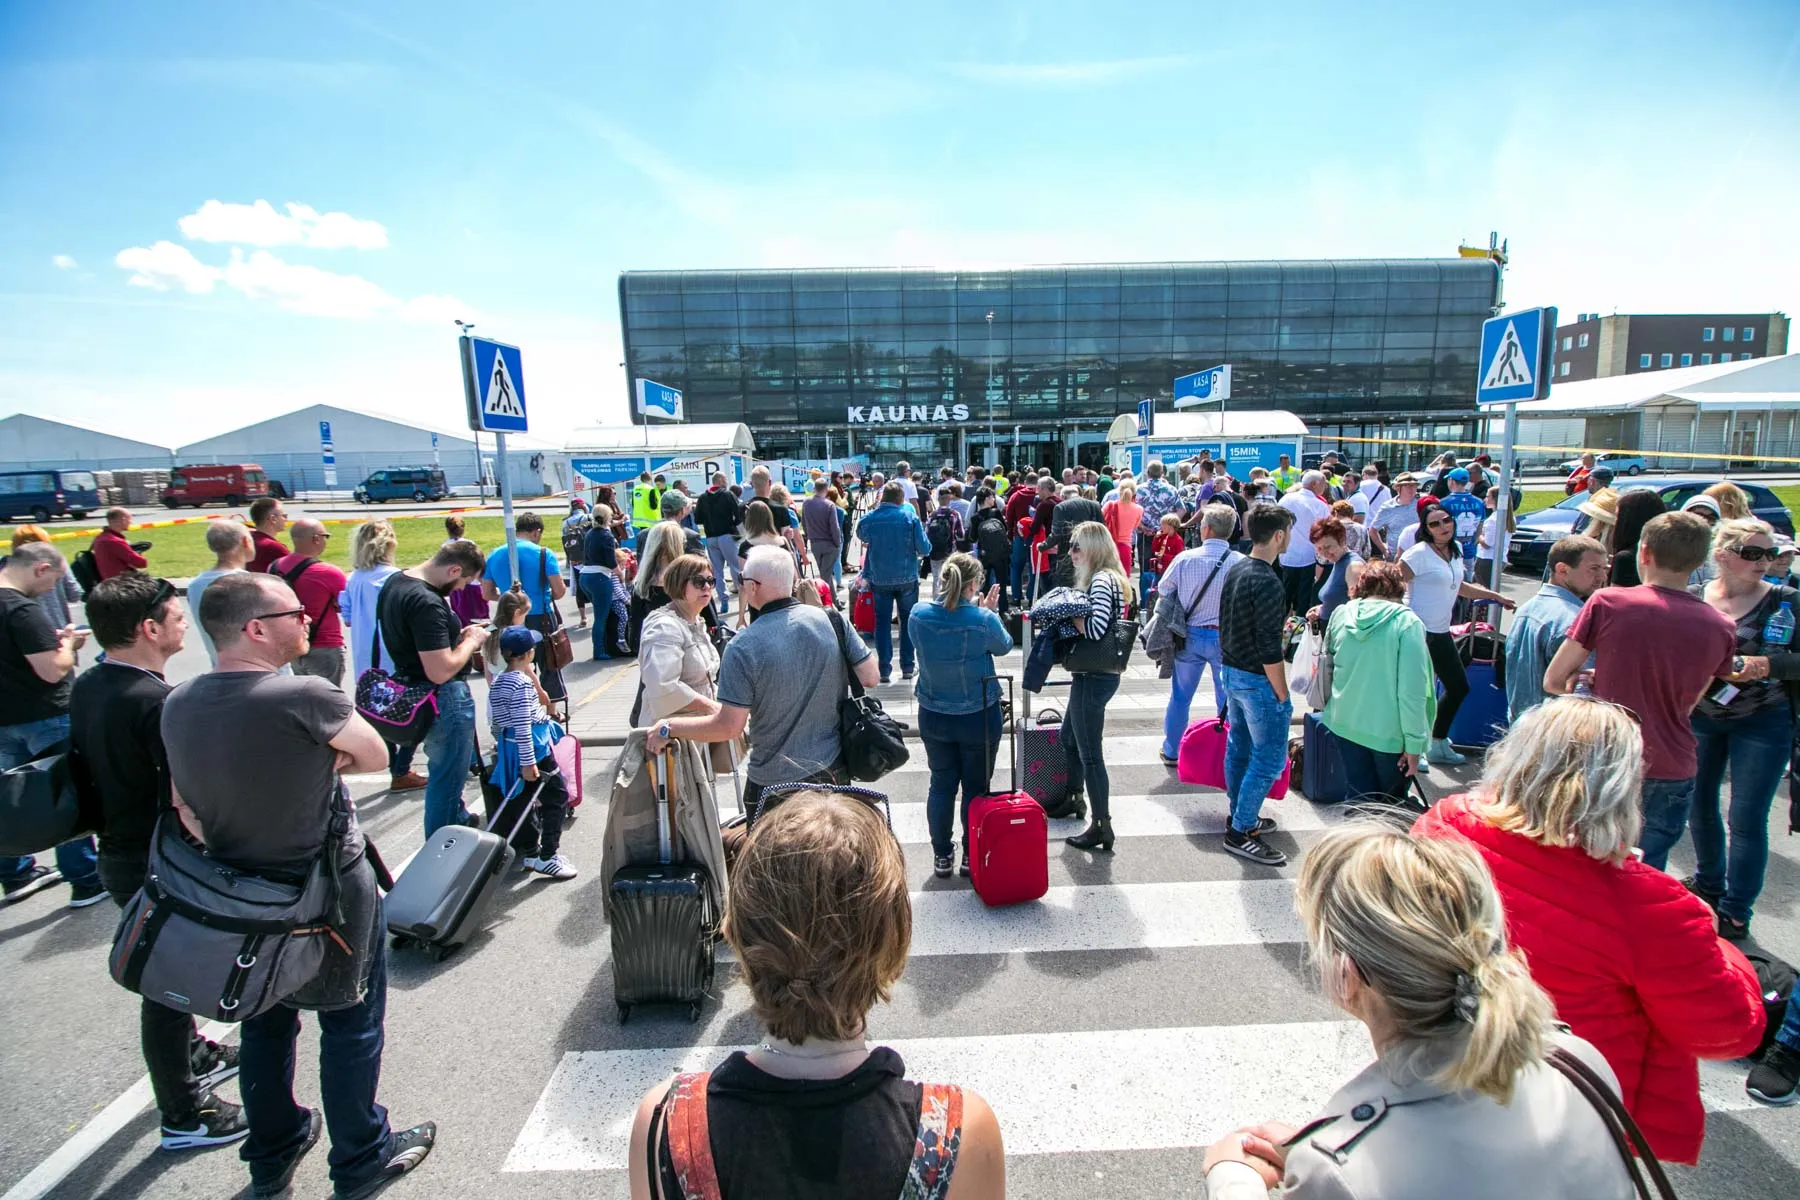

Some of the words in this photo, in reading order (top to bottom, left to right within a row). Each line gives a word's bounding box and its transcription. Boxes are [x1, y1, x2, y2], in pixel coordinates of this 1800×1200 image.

[1193, 375, 1209, 388] KASA
[661, 390, 674, 403] KASA
[847, 404, 969, 422] KAUNAS
[1229, 447, 1261, 456] 15MIN.
[671, 461, 702, 470] 15MIN.
[704, 461, 720, 485] P
